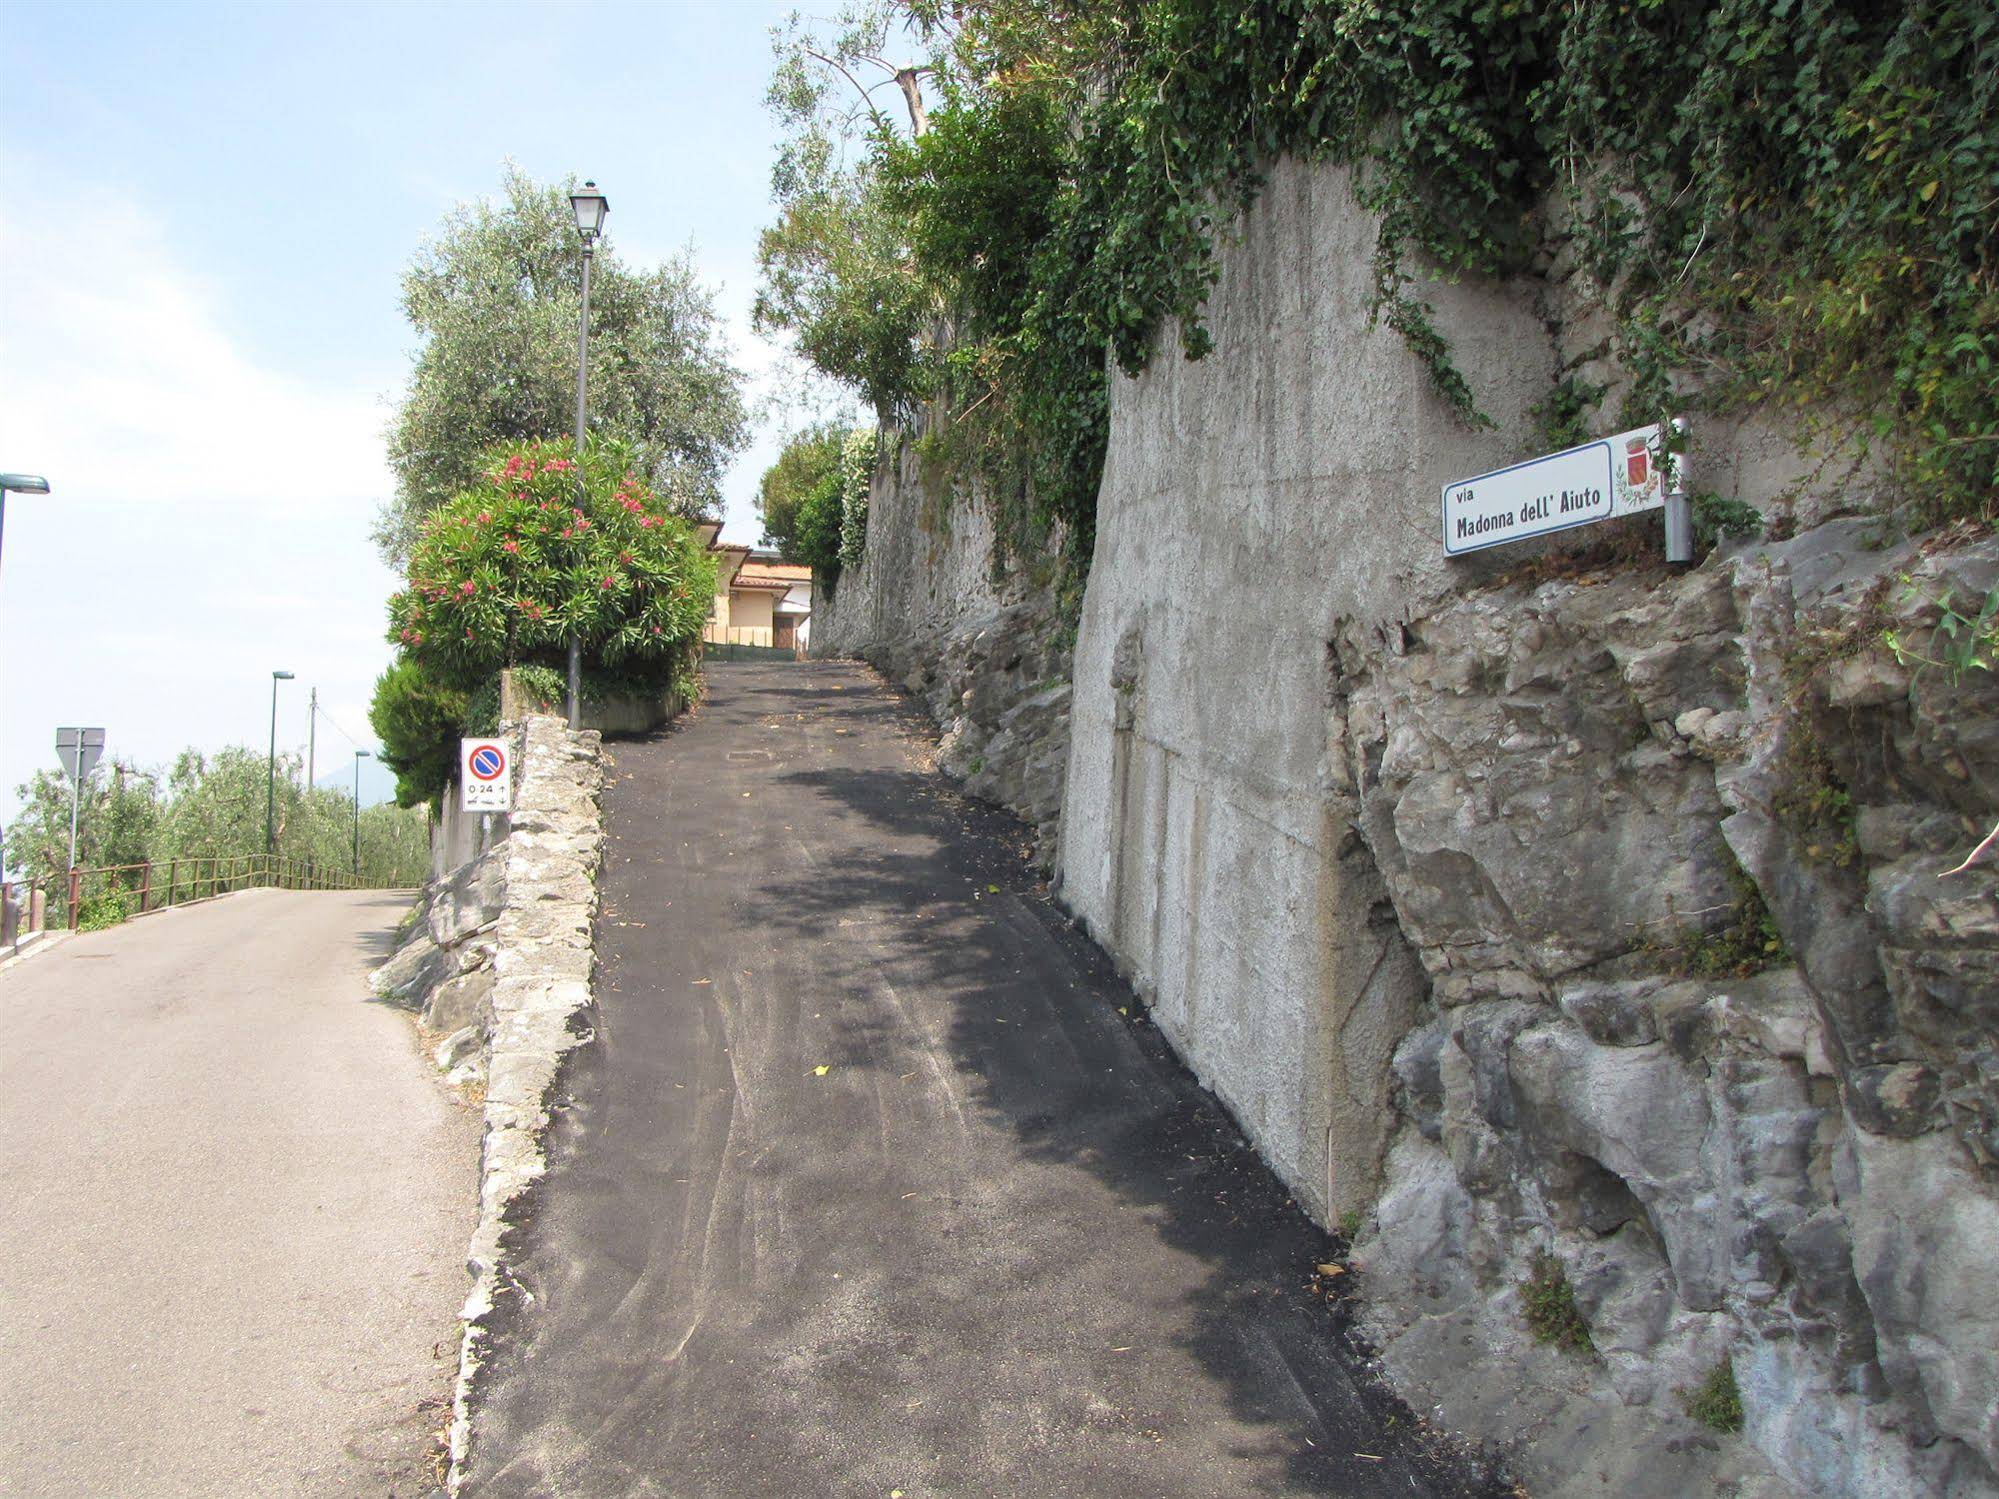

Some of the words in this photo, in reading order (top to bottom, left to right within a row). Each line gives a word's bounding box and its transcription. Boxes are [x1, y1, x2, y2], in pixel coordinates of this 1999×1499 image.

[1456, 488, 1474, 503] via
[1457, 510, 1514, 539] Madonna
[1520, 494, 1554, 523] dell'
[1560, 488, 1601, 513] Aiuto
[480, 785, 493, 793] 24
